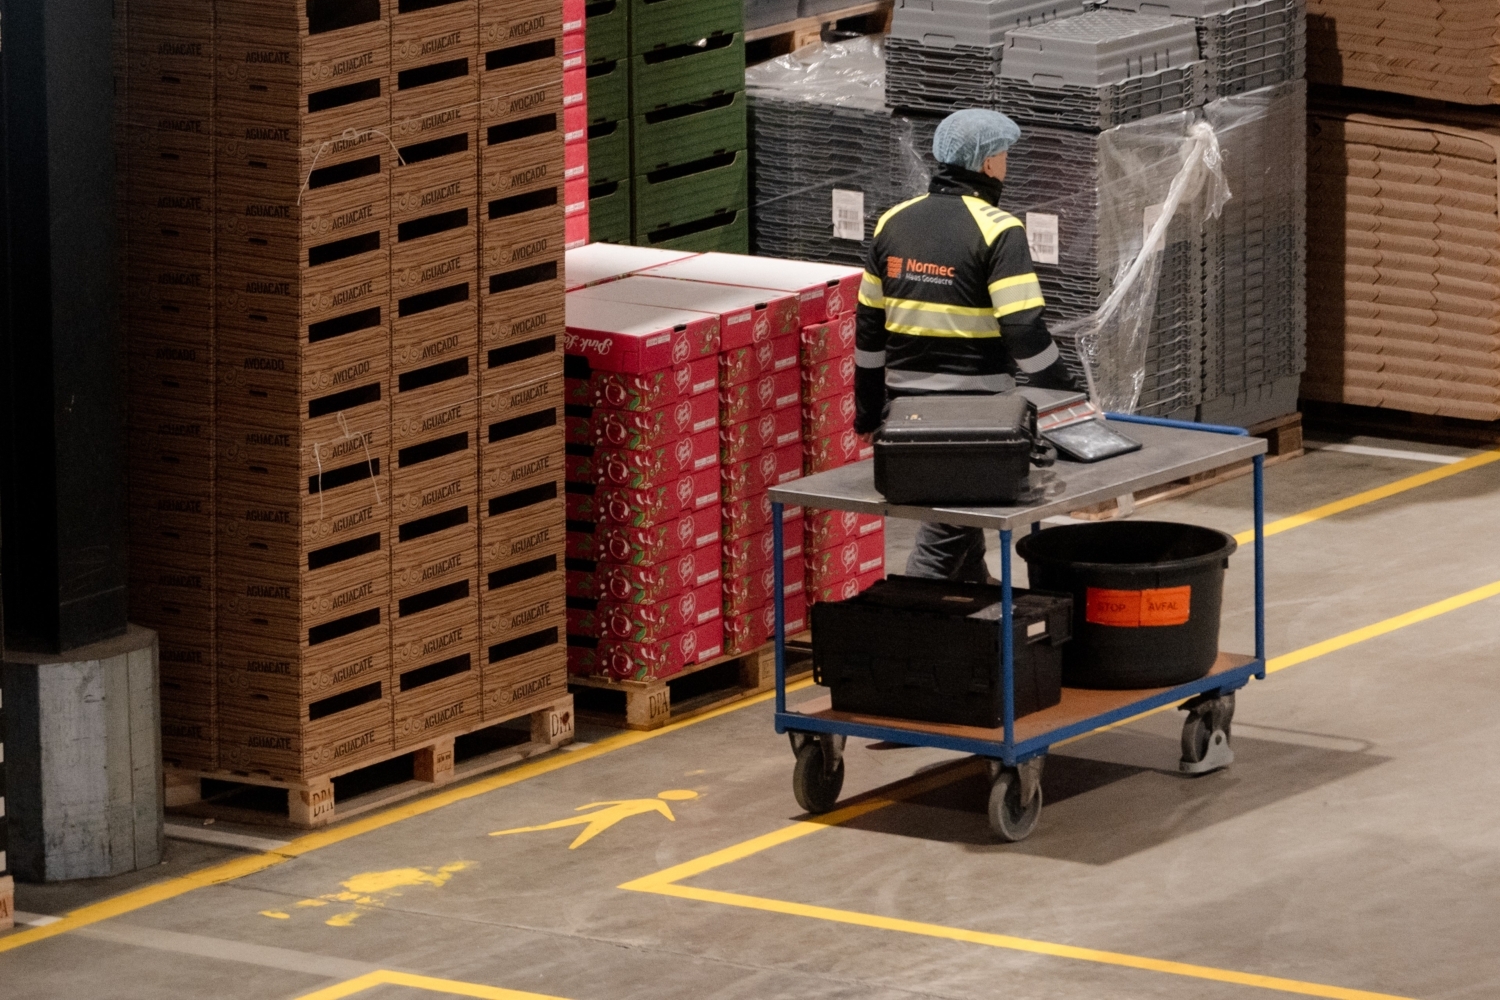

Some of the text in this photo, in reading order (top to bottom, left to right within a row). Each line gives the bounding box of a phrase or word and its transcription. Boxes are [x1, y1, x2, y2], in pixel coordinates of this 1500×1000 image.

[509, 16, 545, 38] AVOCADO
[421, 32, 461, 55] AGUACATE
[245, 52, 290, 63] AGUACATE
[332, 52, 373, 77] AGUACATE
[510, 91, 545, 113] AVOCADO
[421, 109, 461, 132] AGUACATE
[245, 127, 290, 141] AGUACATE
[511, 165, 547, 187] AVOCADO
[421, 182, 461, 207] AGUACATE
[245, 205, 290, 218] AGUACATE
[332, 205, 373, 230] AGUACATE
[512, 239, 547, 262] AVOCADO
[421, 257, 461, 282] AGUACATE
[906, 259, 955, 277] Normec
[245, 281, 290, 295] AGUACATE
[332, 281, 373, 307] AGUACATE
[511, 313, 547, 336] AVOCADO
[422, 335, 458, 359] AVOCADO
[580, 338, 613, 355] Pink
[243, 357, 284, 371] AVOCADO
[333, 361, 370, 386] AVOCADO
[510, 383, 549, 407] AGUACATE
[422, 406, 461, 432] AGUACATE
[245, 433, 290, 448] AGUACATE
[332, 432, 373, 459] AGUACATE
[511, 456, 549, 482] AGUACATE
[421, 481, 461, 507] AGUACATE
[245, 510, 290, 524] AGUACATE
[332, 507, 373, 534] AGUACATE
[511, 529, 549, 555] AGUACATE
[422, 554, 461, 582] AGUACATE
[245, 585, 290, 599] AGUACATE
[332, 582, 373, 610] AGUACATE
[511, 602, 550, 628] AGUACATE
[423, 628, 463, 656] AGUACATE
[246, 660, 290, 674] AGUACATE
[332, 656, 373, 685] AGUACATE
[512, 674, 551, 702] AGUACATE
[424, 702, 464, 730] AGUACATE
[248, 736, 292, 750] AGUACATE
[334, 731, 375, 759] AGUACATE
[312, 789, 334, 818] DPA
